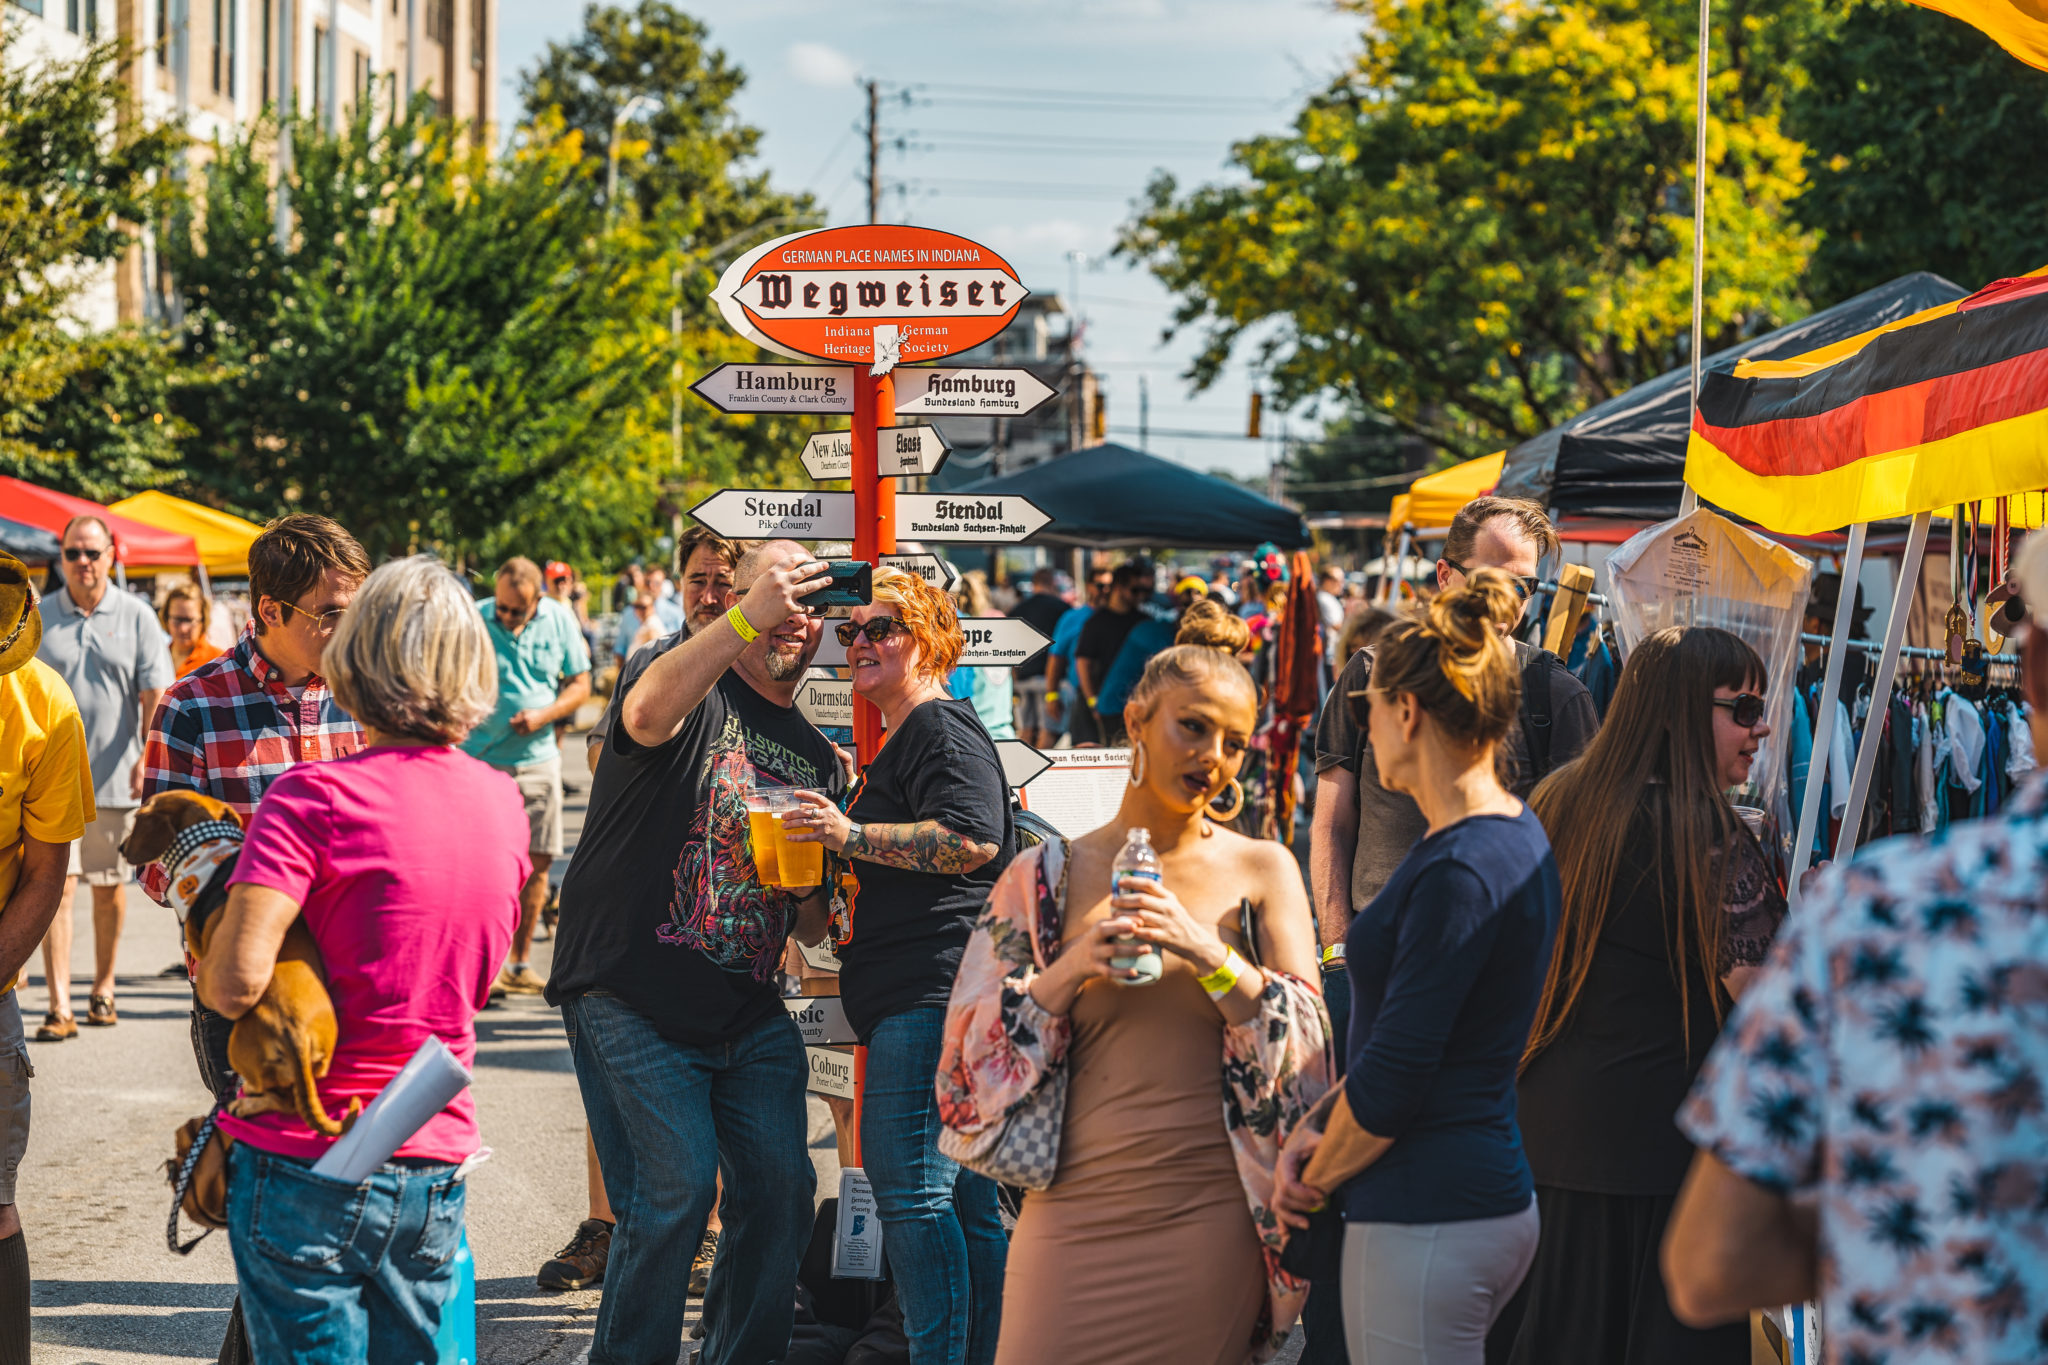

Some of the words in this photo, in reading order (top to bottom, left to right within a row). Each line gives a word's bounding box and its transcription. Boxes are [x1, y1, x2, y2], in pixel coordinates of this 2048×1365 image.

[782, 249, 833, 264] GERMAN
[835, 249, 871, 263] PLACE
[874, 249, 914, 263] NAMES
[917, 249, 929, 262] IN
[931, 248, 980, 262] INDIANA
[756, 273, 1007, 316] Wegweiser
[824, 325, 871, 337] Indiana
[903, 325, 949, 336] German
[824, 343, 871, 357] Heritage
[904, 341, 949, 355] Society
[735, 370, 836, 396] Hamburg
[927, 373, 1016, 398] Hamburg
[728, 393, 759, 403] Franklin
[761, 394, 787, 405] County
[789, 395, 798, 404] &
[799, 394, 819, 404] Clark
[820, 395, 847, 406] County
[924, 397, 976, 407] Bundesland
[979, 398, 1020, 410] Hamburg
[812, 440, 829, 458] New
[744, 497, 823, 518] Stendal
[935, 500, 1003, 520] Stendal
[758, 519, 778, 530] Pike
[780, 519, 812, 532] County
[911, 523, 960, 533] Bundesland
[963, 523, 1027, 534] Sachsen-Anhalt
[809, 687, 854, 706] Darmstad
[1071, 753, 1101, 763] Heritage
[811, 1054, 849, 1083] Coburg
[816, 1077, 830, 1087] Porter
[830, 1078, 846, 1092] County
